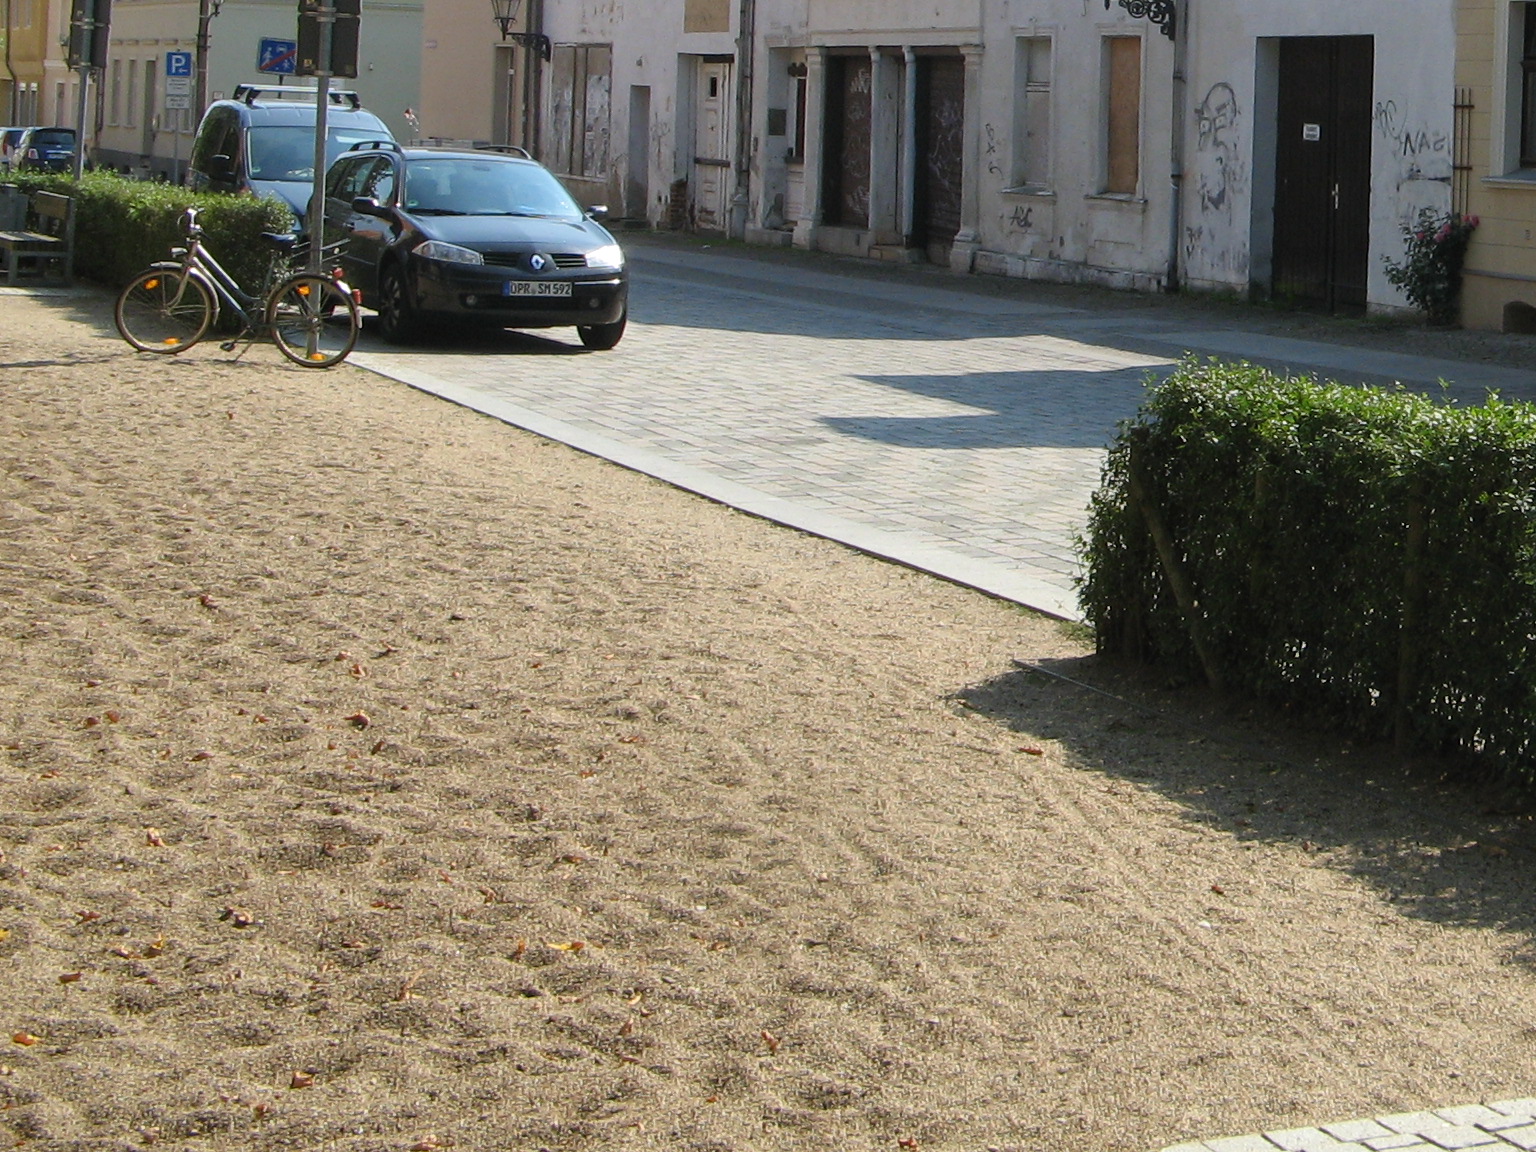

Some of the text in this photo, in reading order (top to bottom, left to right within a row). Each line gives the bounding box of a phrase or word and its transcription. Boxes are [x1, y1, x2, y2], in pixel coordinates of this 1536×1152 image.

[172, 55, 186, 74] P
[510, 283, 570, 295] OPR SM 592
